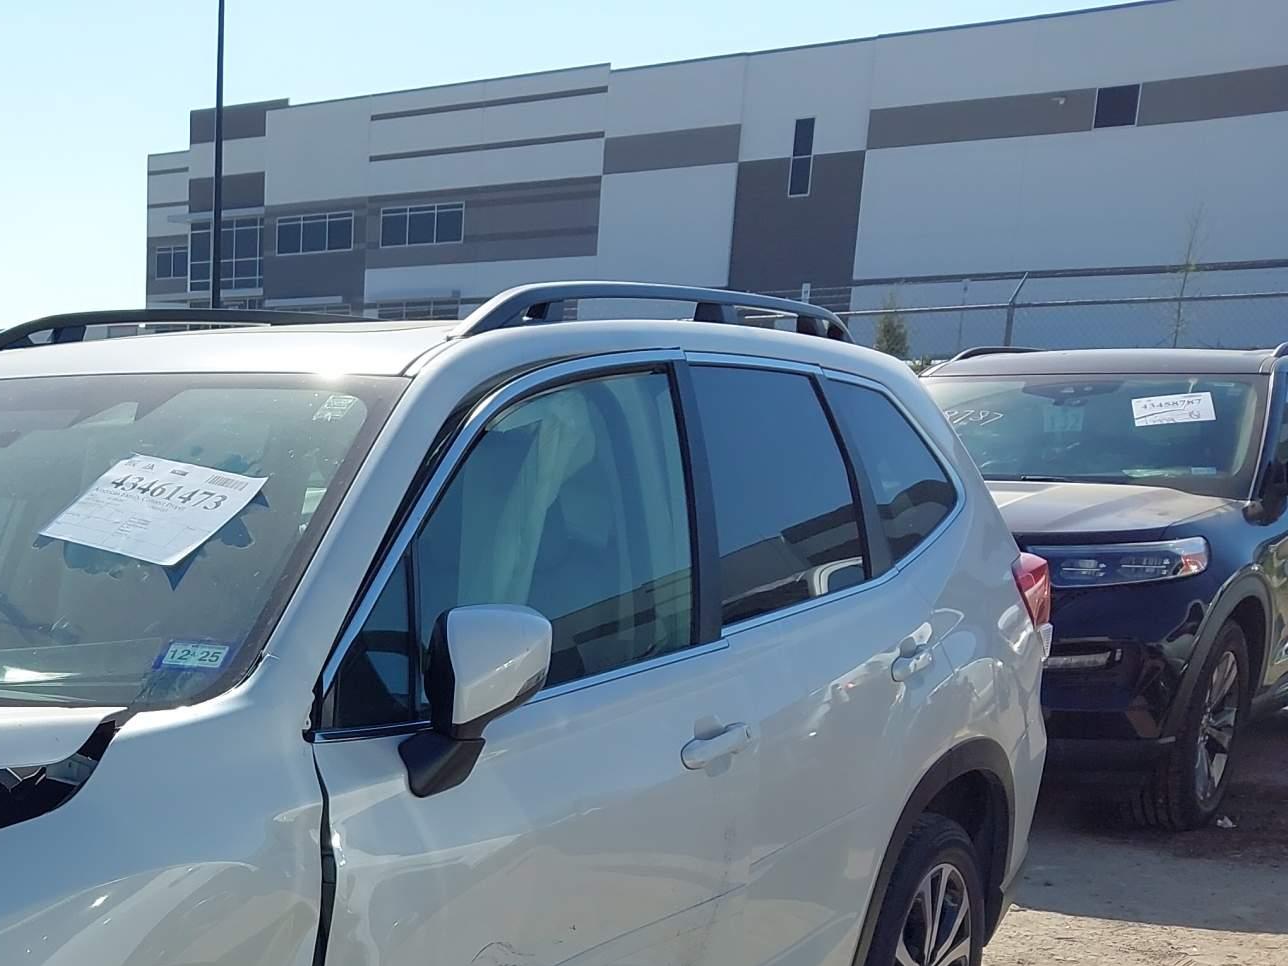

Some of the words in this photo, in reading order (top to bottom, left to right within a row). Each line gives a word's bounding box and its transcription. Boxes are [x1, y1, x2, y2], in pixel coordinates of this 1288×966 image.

[111, 473, 229, 511] 43461473
[169, 648, 190, 661] 12
[197, 650, 221, 663] 25
